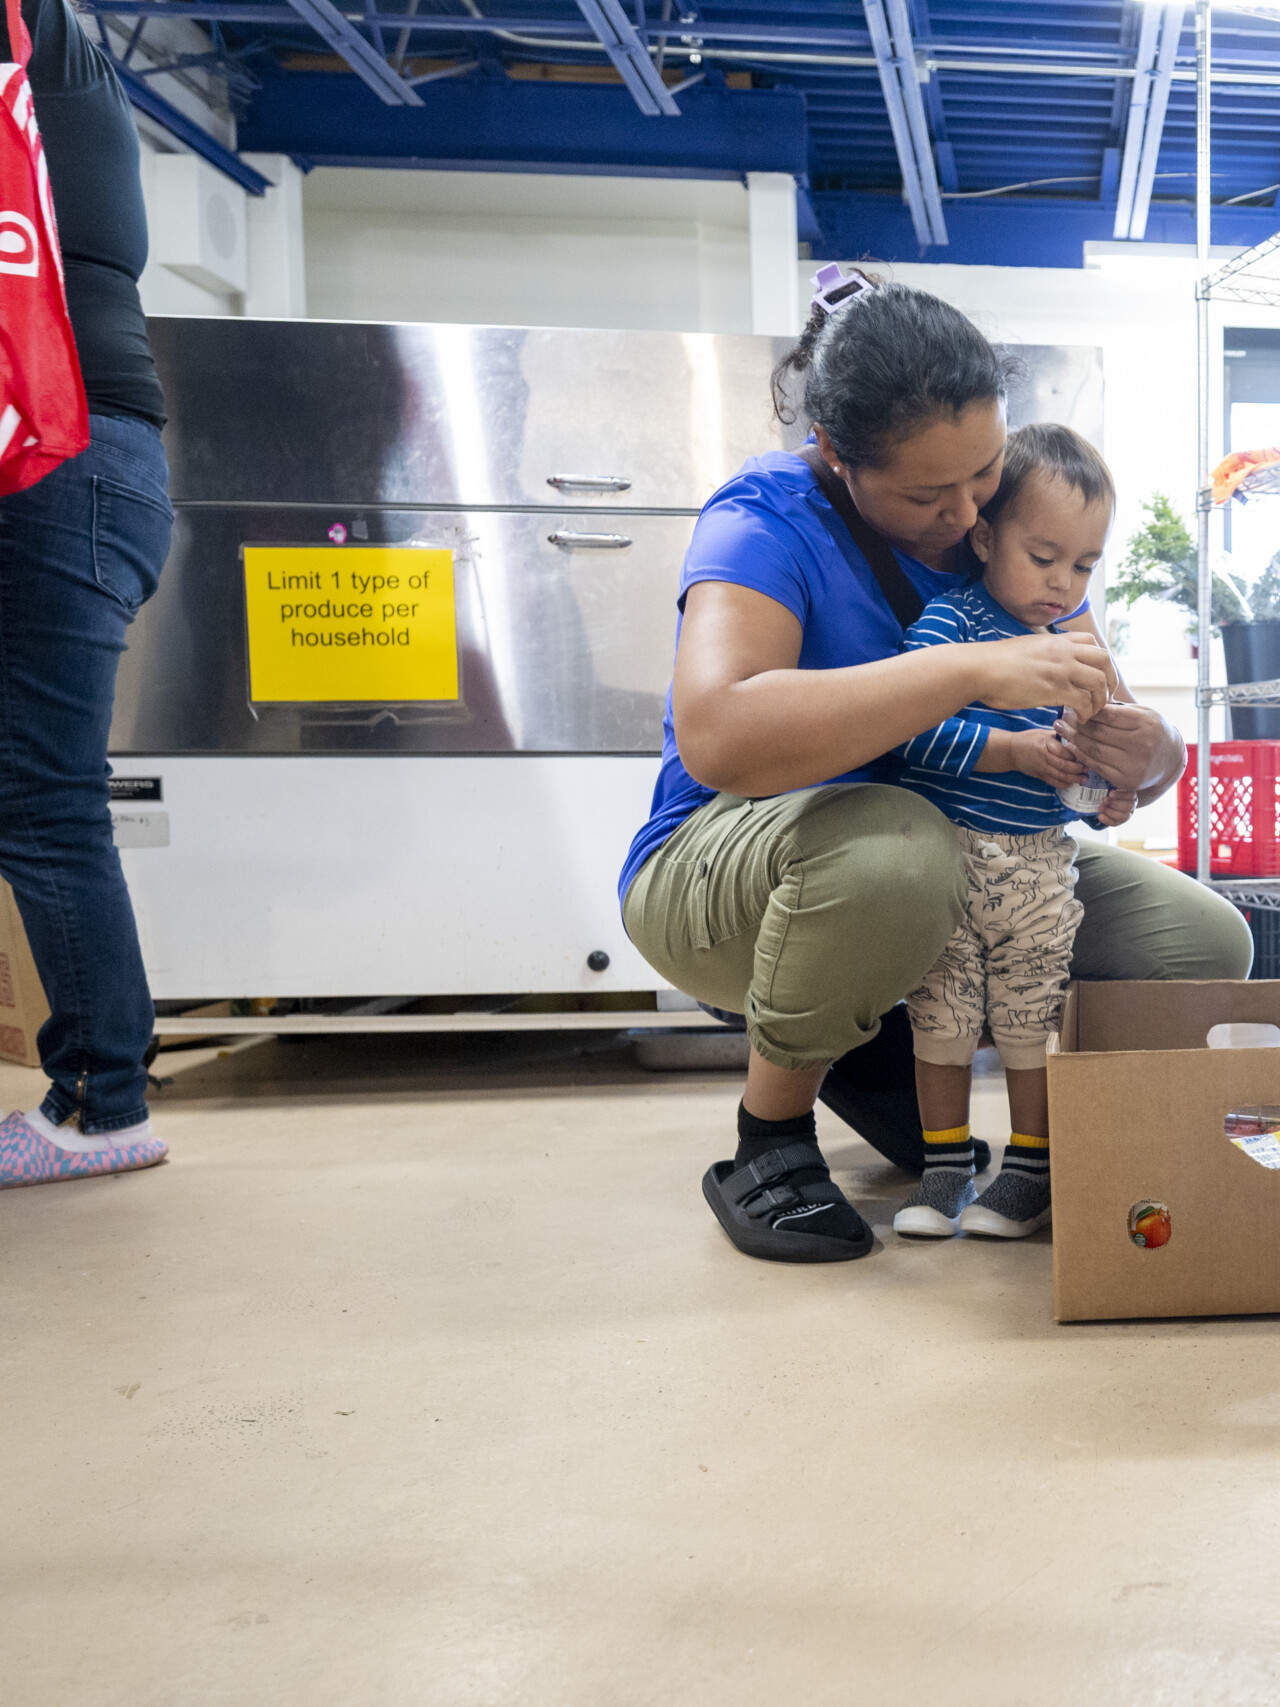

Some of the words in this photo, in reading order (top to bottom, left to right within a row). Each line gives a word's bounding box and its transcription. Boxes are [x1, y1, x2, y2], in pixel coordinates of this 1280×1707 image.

[267, 571, 322, 590] Limit
[330, 571, 341, 590] 1
[351, 571, 400, 594] type
[408, 570, 431, 590] of
[281, 599, 374, 623] produce
[382, 602, 419, 623] per
[291, 627, 411, 647] household
